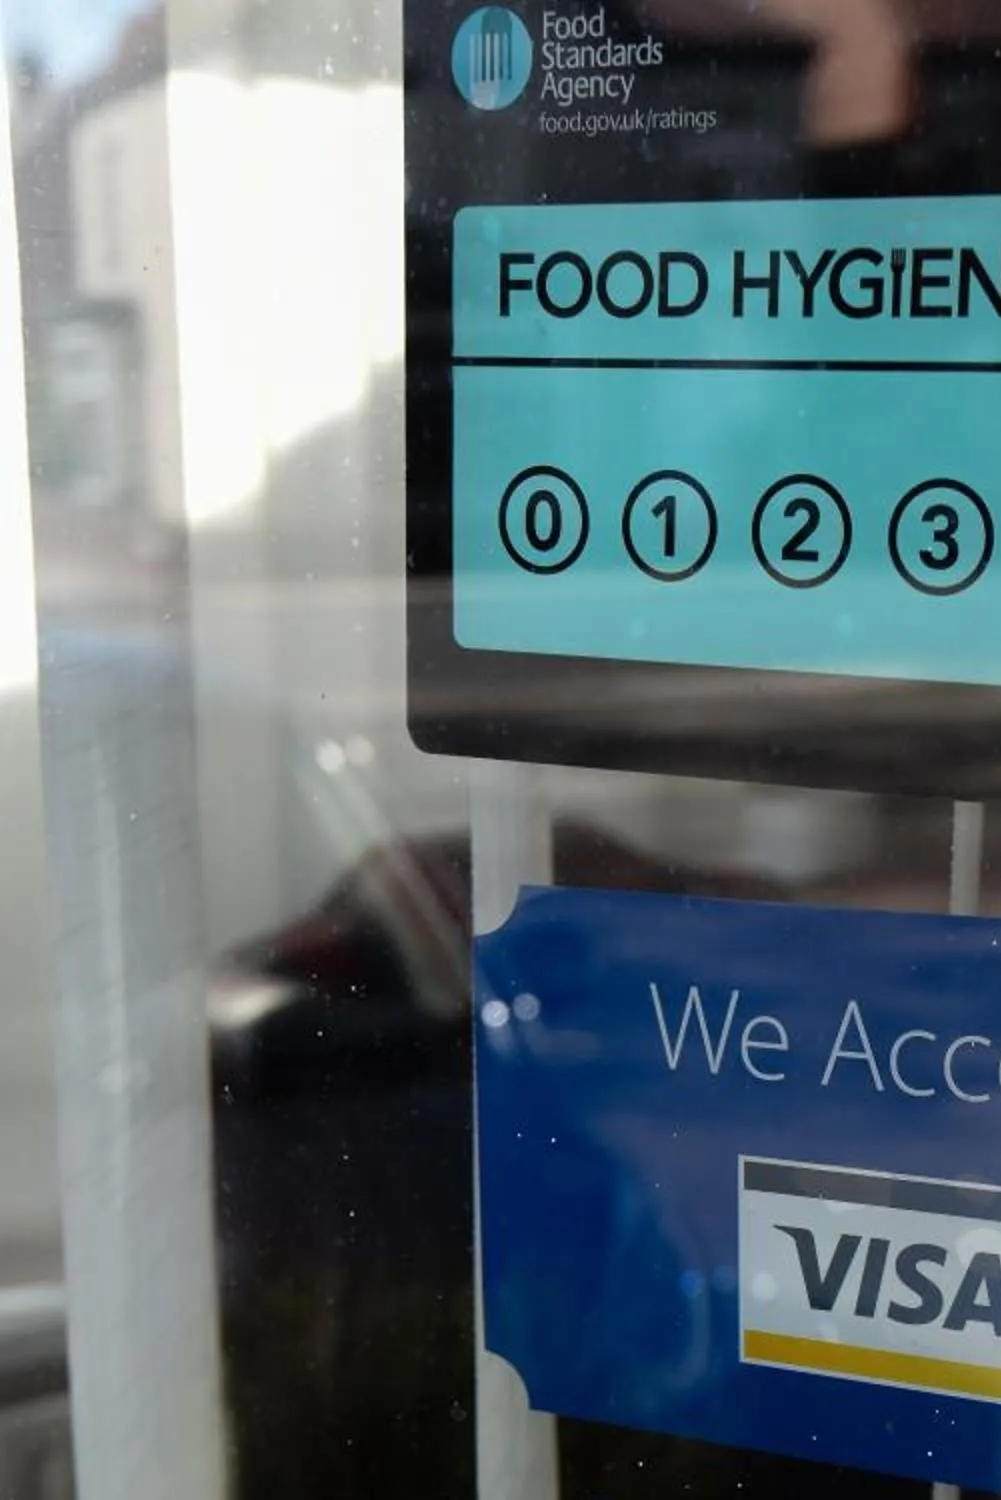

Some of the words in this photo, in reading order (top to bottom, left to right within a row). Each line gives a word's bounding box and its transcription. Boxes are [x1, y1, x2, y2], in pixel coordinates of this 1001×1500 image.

[543, 8, 605, 40] Food
[541, 36, 664, 71] Standards
[540, 72, 635, 107] Agency
[540, 107, 717, 137] food.gov.uk/ratings
[498, 249, 710, 319] FOOD
[524, 489, 562, 552] 0
[650, 495, 677, 557] 1
[780, 497, 821, 563] 2
[918, 503, 960, 570] 3
[649, 981, 790, 1082] We
